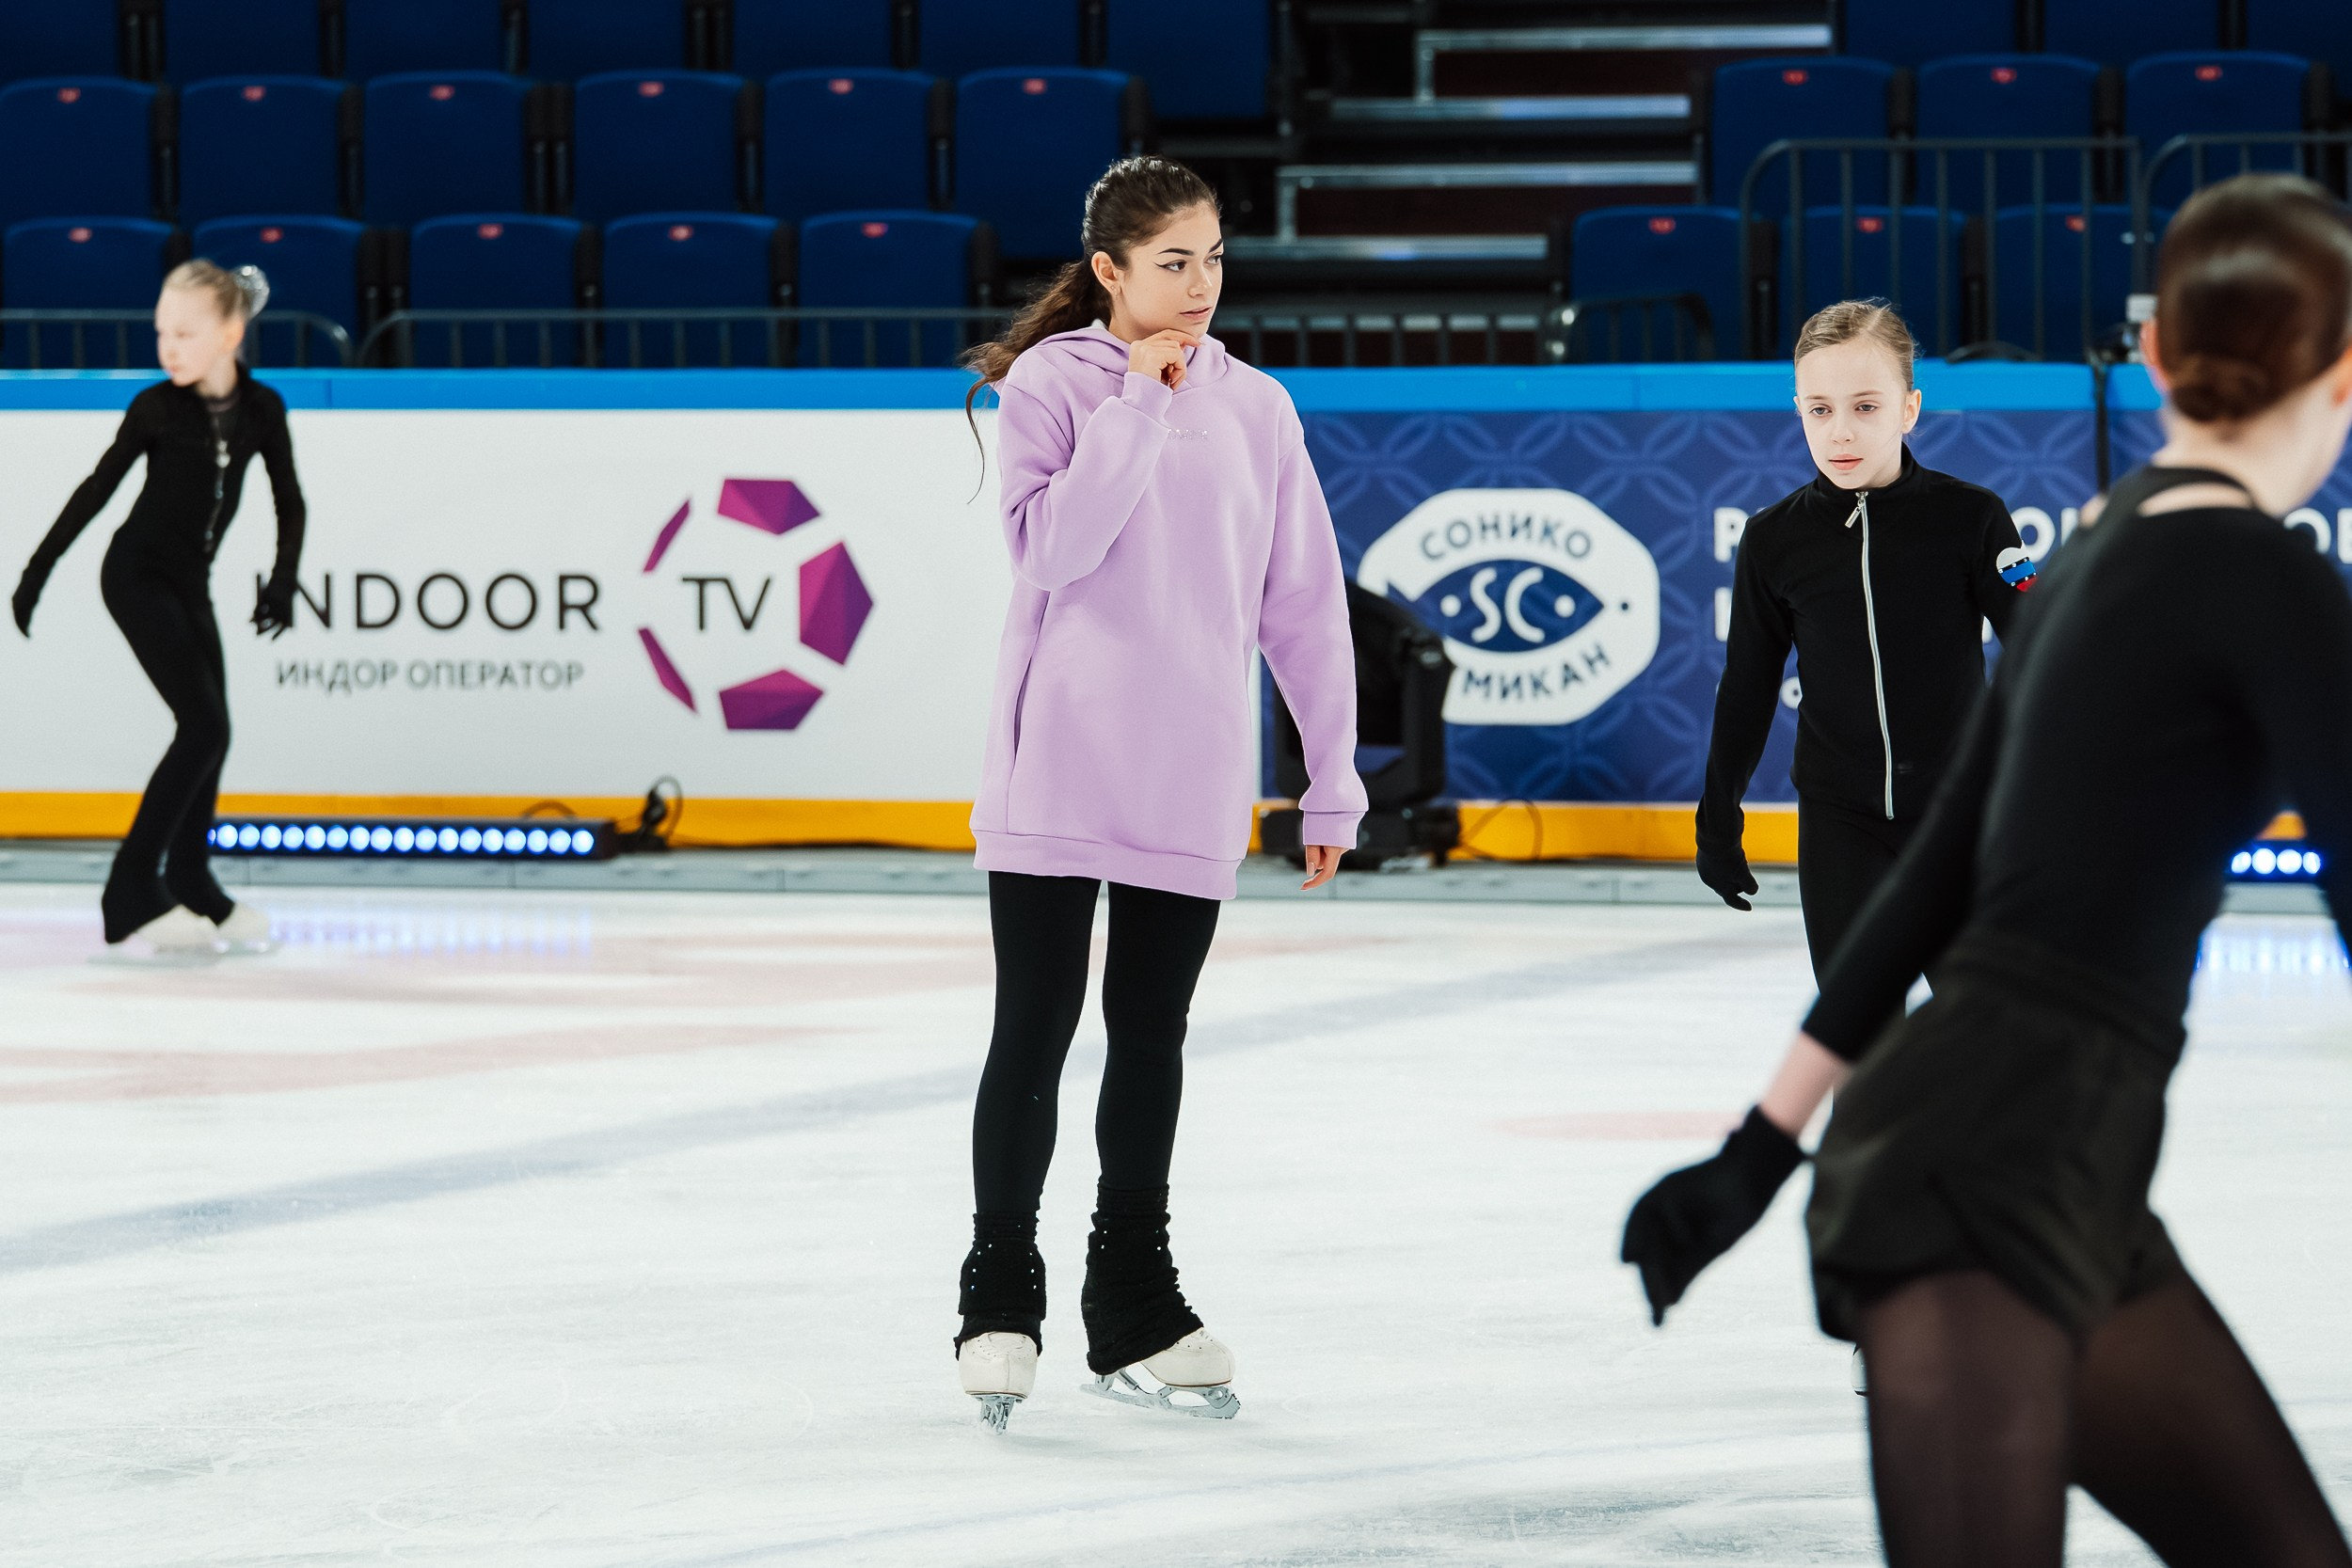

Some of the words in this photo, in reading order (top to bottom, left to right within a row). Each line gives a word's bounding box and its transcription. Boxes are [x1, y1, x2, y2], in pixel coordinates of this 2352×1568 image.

[1421, 512, 1593, 562] СОНИКО
[681, 576, 771, 630] TV
[278, 660, 398, 694] ИНДОР
[406, 659, 584, 690] ОПЕРАТОР
[1462, 642, 1613, 701] МИКАН
